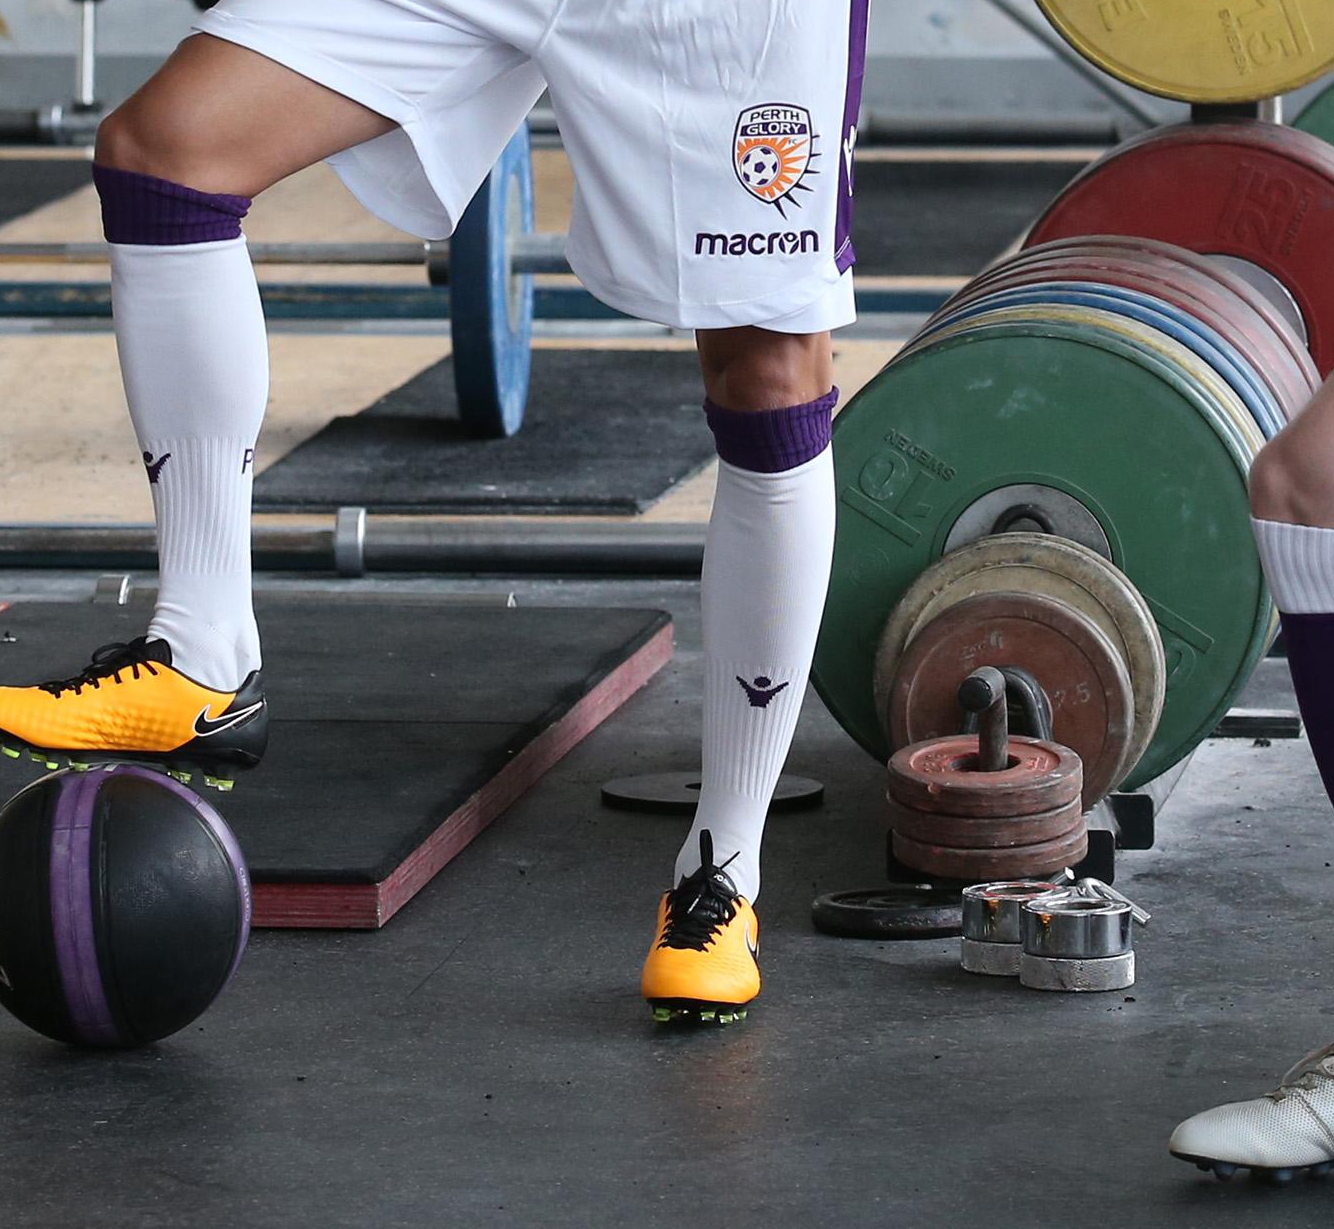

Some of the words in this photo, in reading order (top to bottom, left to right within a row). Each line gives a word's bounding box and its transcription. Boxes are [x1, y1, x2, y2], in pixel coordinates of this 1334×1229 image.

[749, 109, 800, 122] PERTH
[747, 123, 801, 135] GLORY
[695, 229, 820, 256] macron
